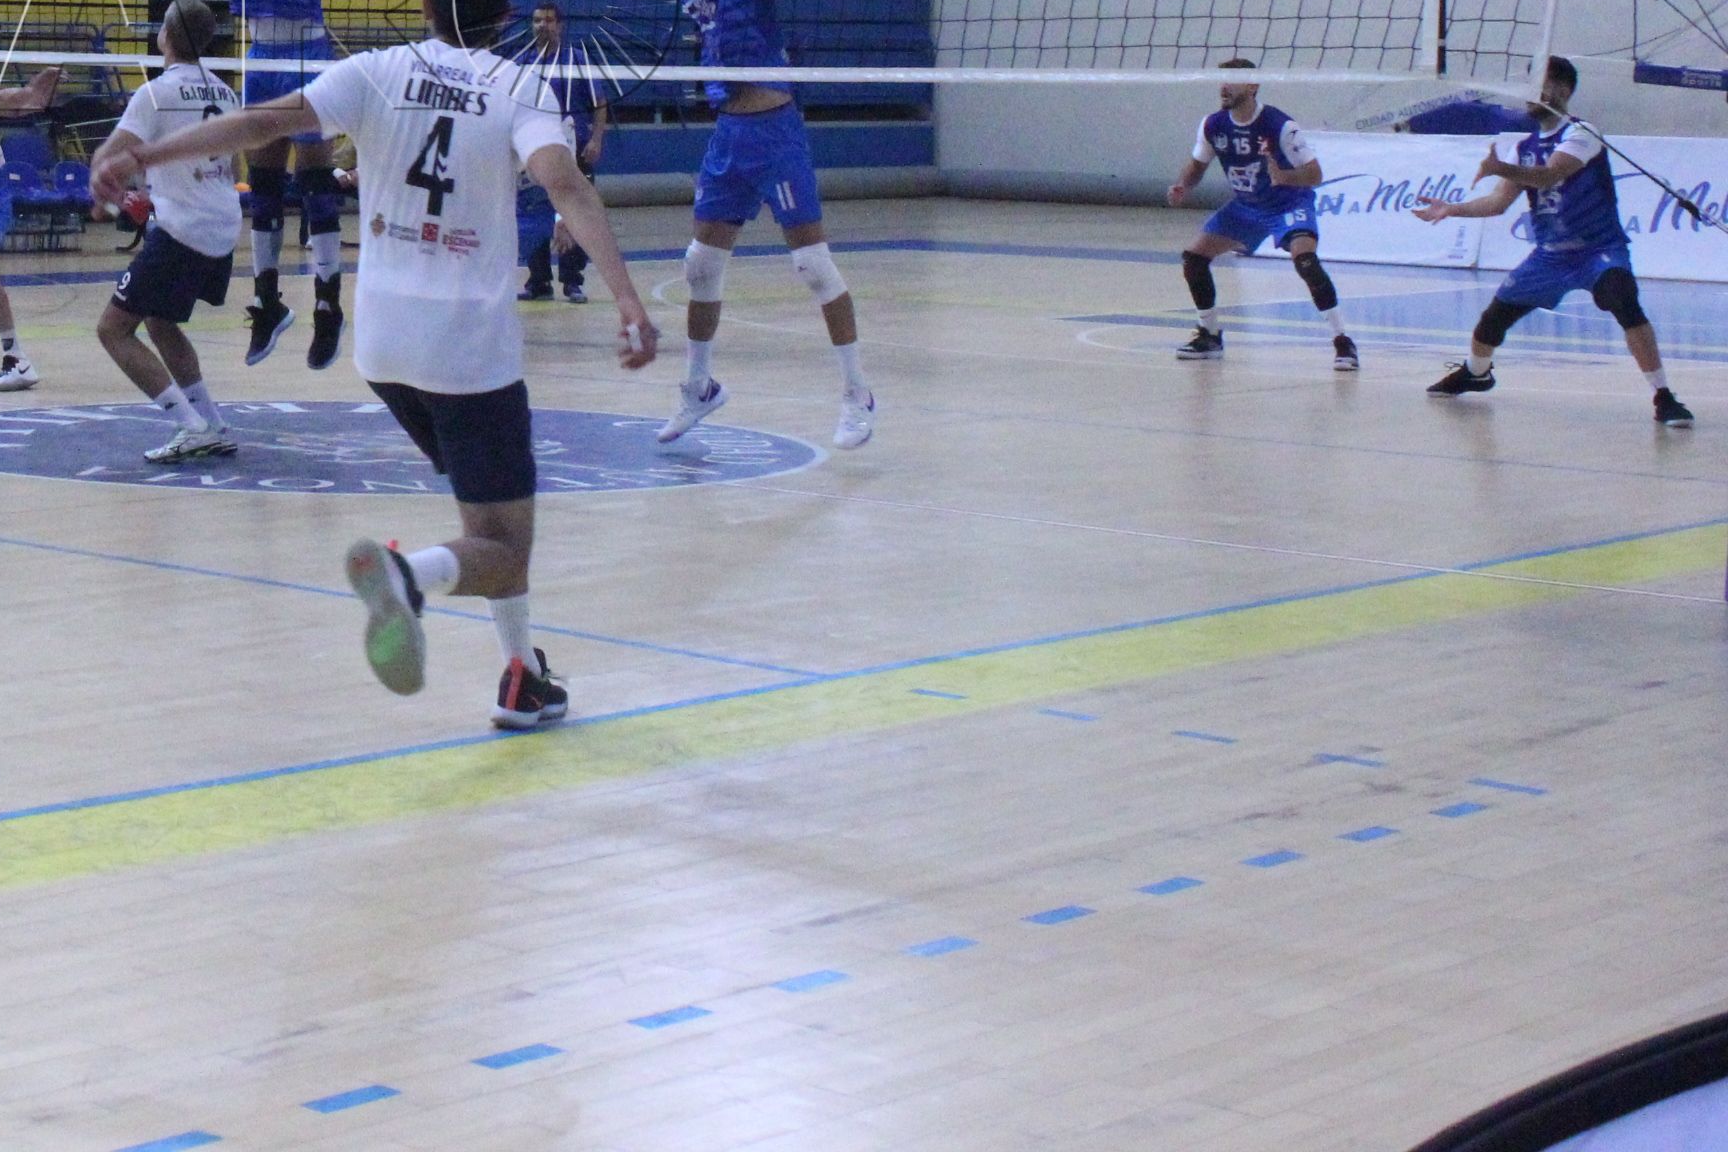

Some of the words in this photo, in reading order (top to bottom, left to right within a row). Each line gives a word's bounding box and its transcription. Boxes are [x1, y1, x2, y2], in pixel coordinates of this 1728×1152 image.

[404, 78, 491, 117] LINARES
[1232, 137, 1251, 156] 15
[406, 115, 455, 217] 4
[775, 180, 797, 211] 11
[1366, 173, 1467, 214] Melilla
[119, 271, 131, 290] 9
